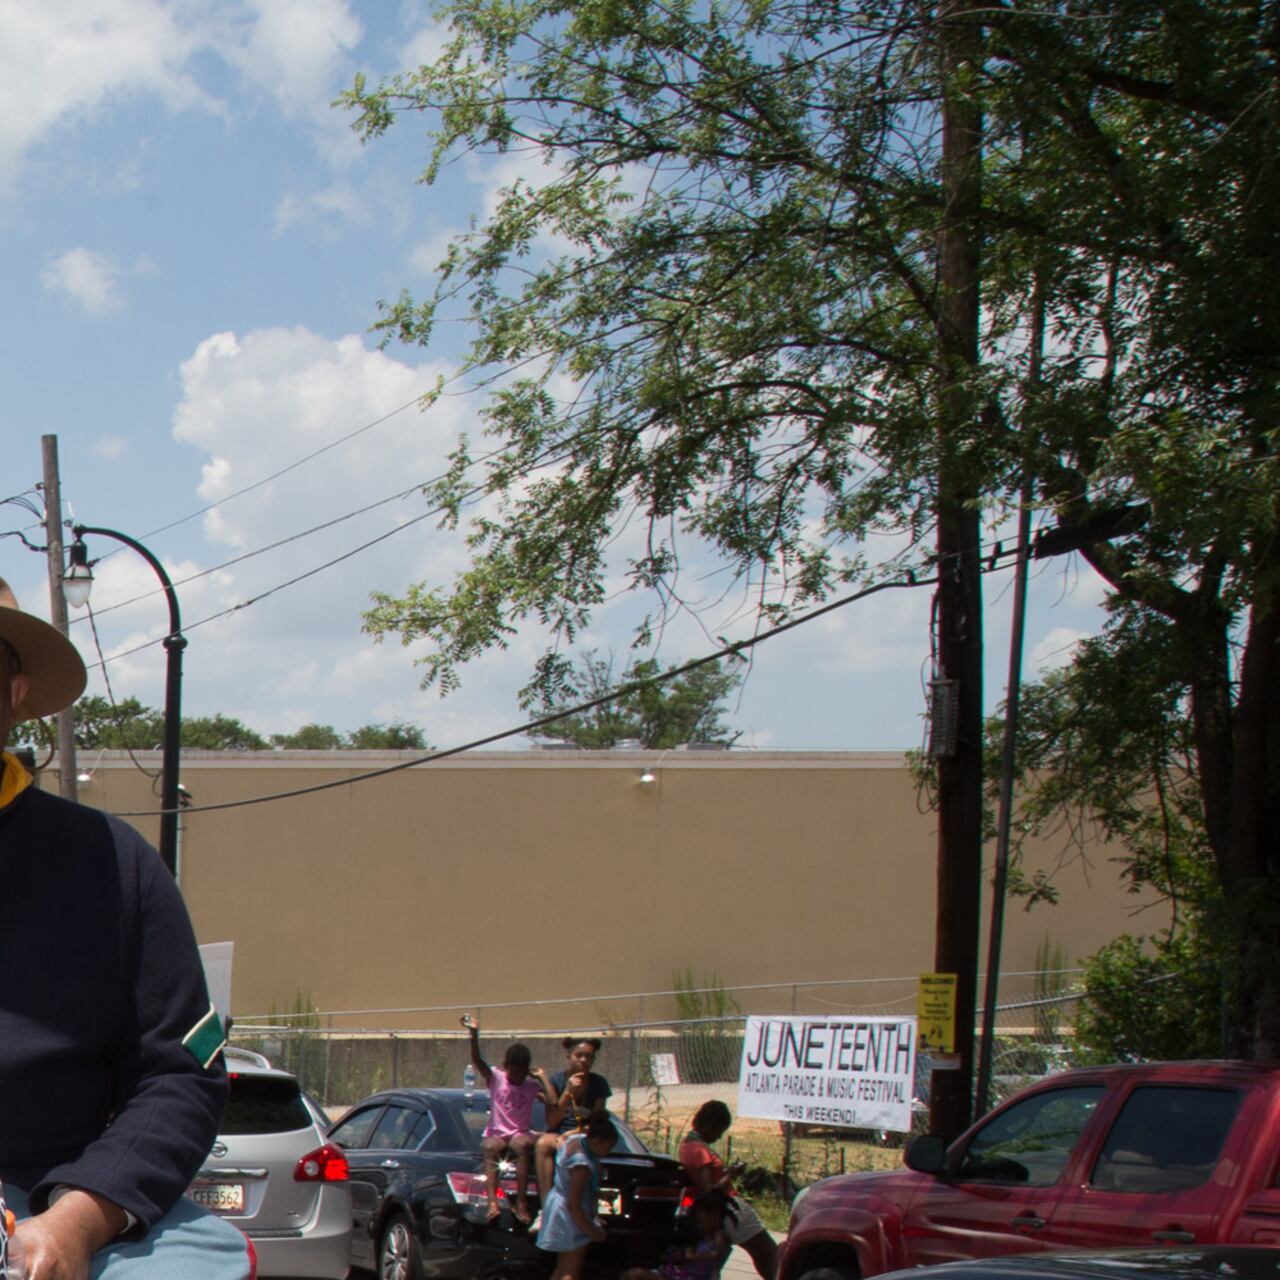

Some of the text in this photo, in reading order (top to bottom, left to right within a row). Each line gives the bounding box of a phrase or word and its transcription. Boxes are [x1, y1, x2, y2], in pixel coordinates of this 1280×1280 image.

[747, 1021, 913, 1075] JUNETEENTH
[744, 1072, 905, 1104] ATLANTA PARADE & MUSIC FESTIVAL
[784, 1104, 856, 1124] THIS WEEKEND!
